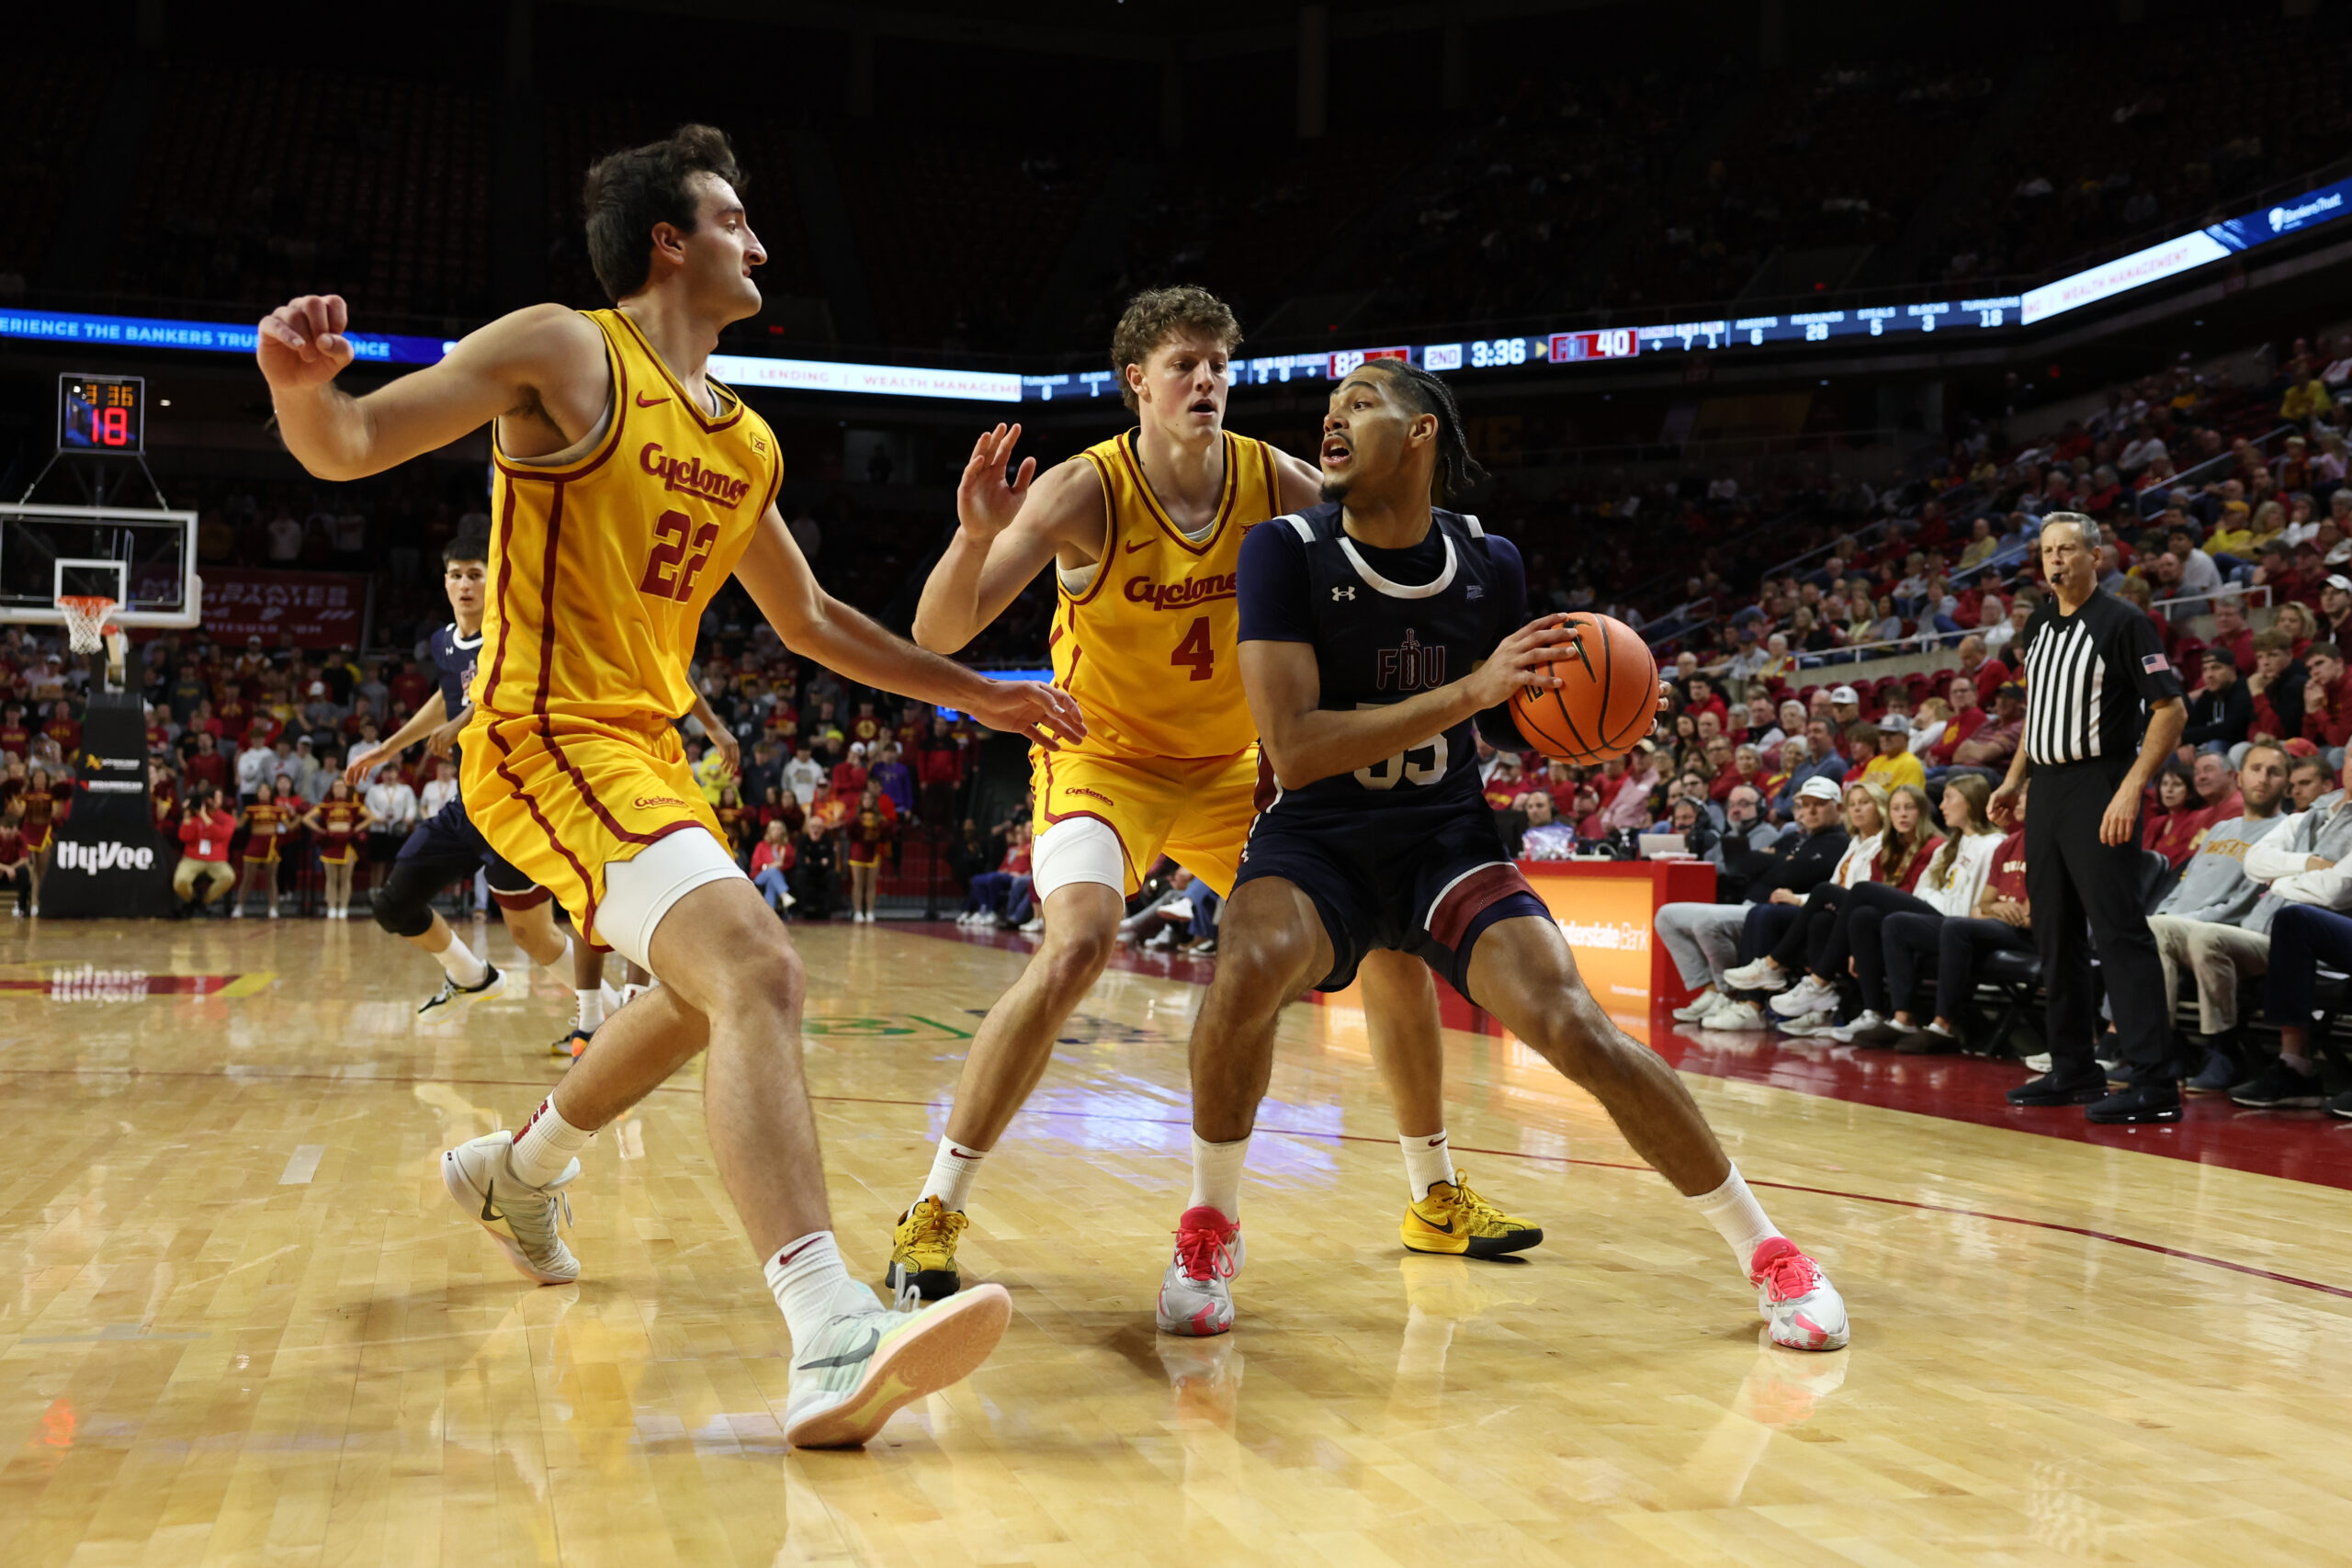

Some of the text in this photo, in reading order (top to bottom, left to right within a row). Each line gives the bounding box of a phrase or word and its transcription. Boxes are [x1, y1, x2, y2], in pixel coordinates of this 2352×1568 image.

[1858, 307, 1895, 320] STEALS
[1907, 302, 1950, 316] BLOCKS
[1870, 318, 1883, 336] 5
[1922, 314, 1935, 332] 3
[1979, 309, 2003, 327] 18
[84, 323, 120, 339] THE
[126, 326, 212, 346] BANKERS
[1429, 349, 1458, 367] 2ND
[1471, 338, 1526, 367] 3:36
[1597, 330, 1630, 356] 40
[760, 369, 830, 382] LENDING
[864, 376, 927, 388] WEALTH
[92, 407, 128, 446] 18
[639, 442, 751, 510] Cyclones
[639, 508, 720, 604] 22
[1124, 570, 1238, 612] Cyclone
[1170, 615, 1215, 682] 4
[1376, 645, 1446, 691] FDU
[1065, 787, 1114, 807] Cyclones
